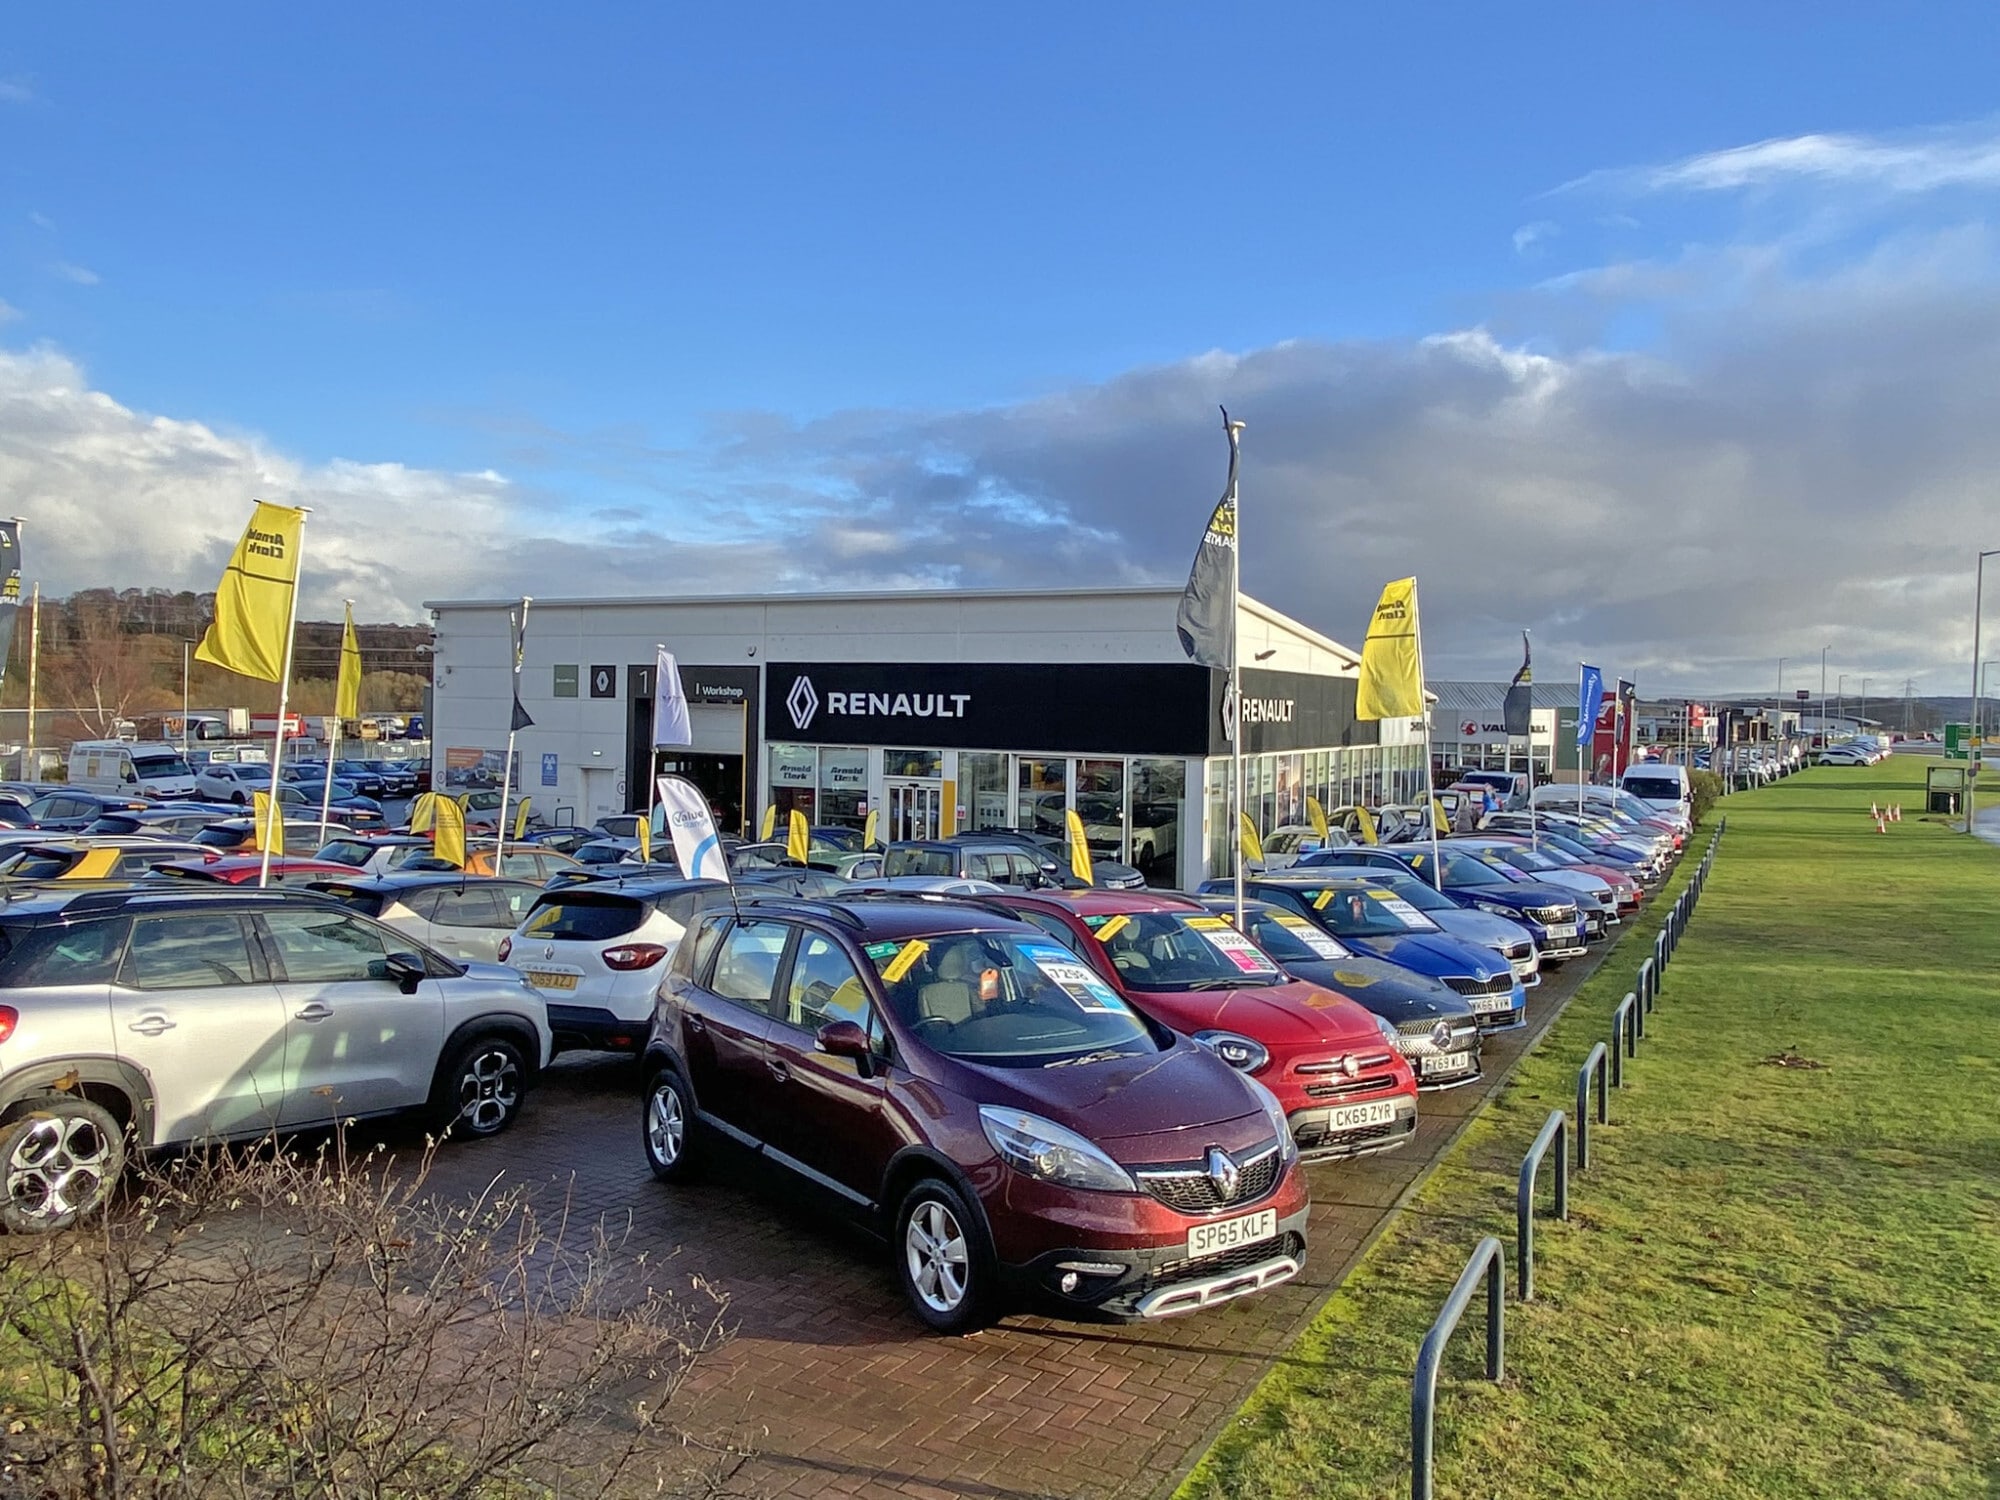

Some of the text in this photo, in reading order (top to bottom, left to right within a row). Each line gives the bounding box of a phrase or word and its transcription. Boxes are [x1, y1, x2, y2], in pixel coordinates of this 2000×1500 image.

[702, 685, 744, 698] Workshop
[828, 692, 971, 718] RENAULT
[1242, 698, 1294, 722] RENAULT
[1336, 1103, 1391, 1127] CK69 ZYR
[1196, 1213, 1269, 1250] SP65 KLF
